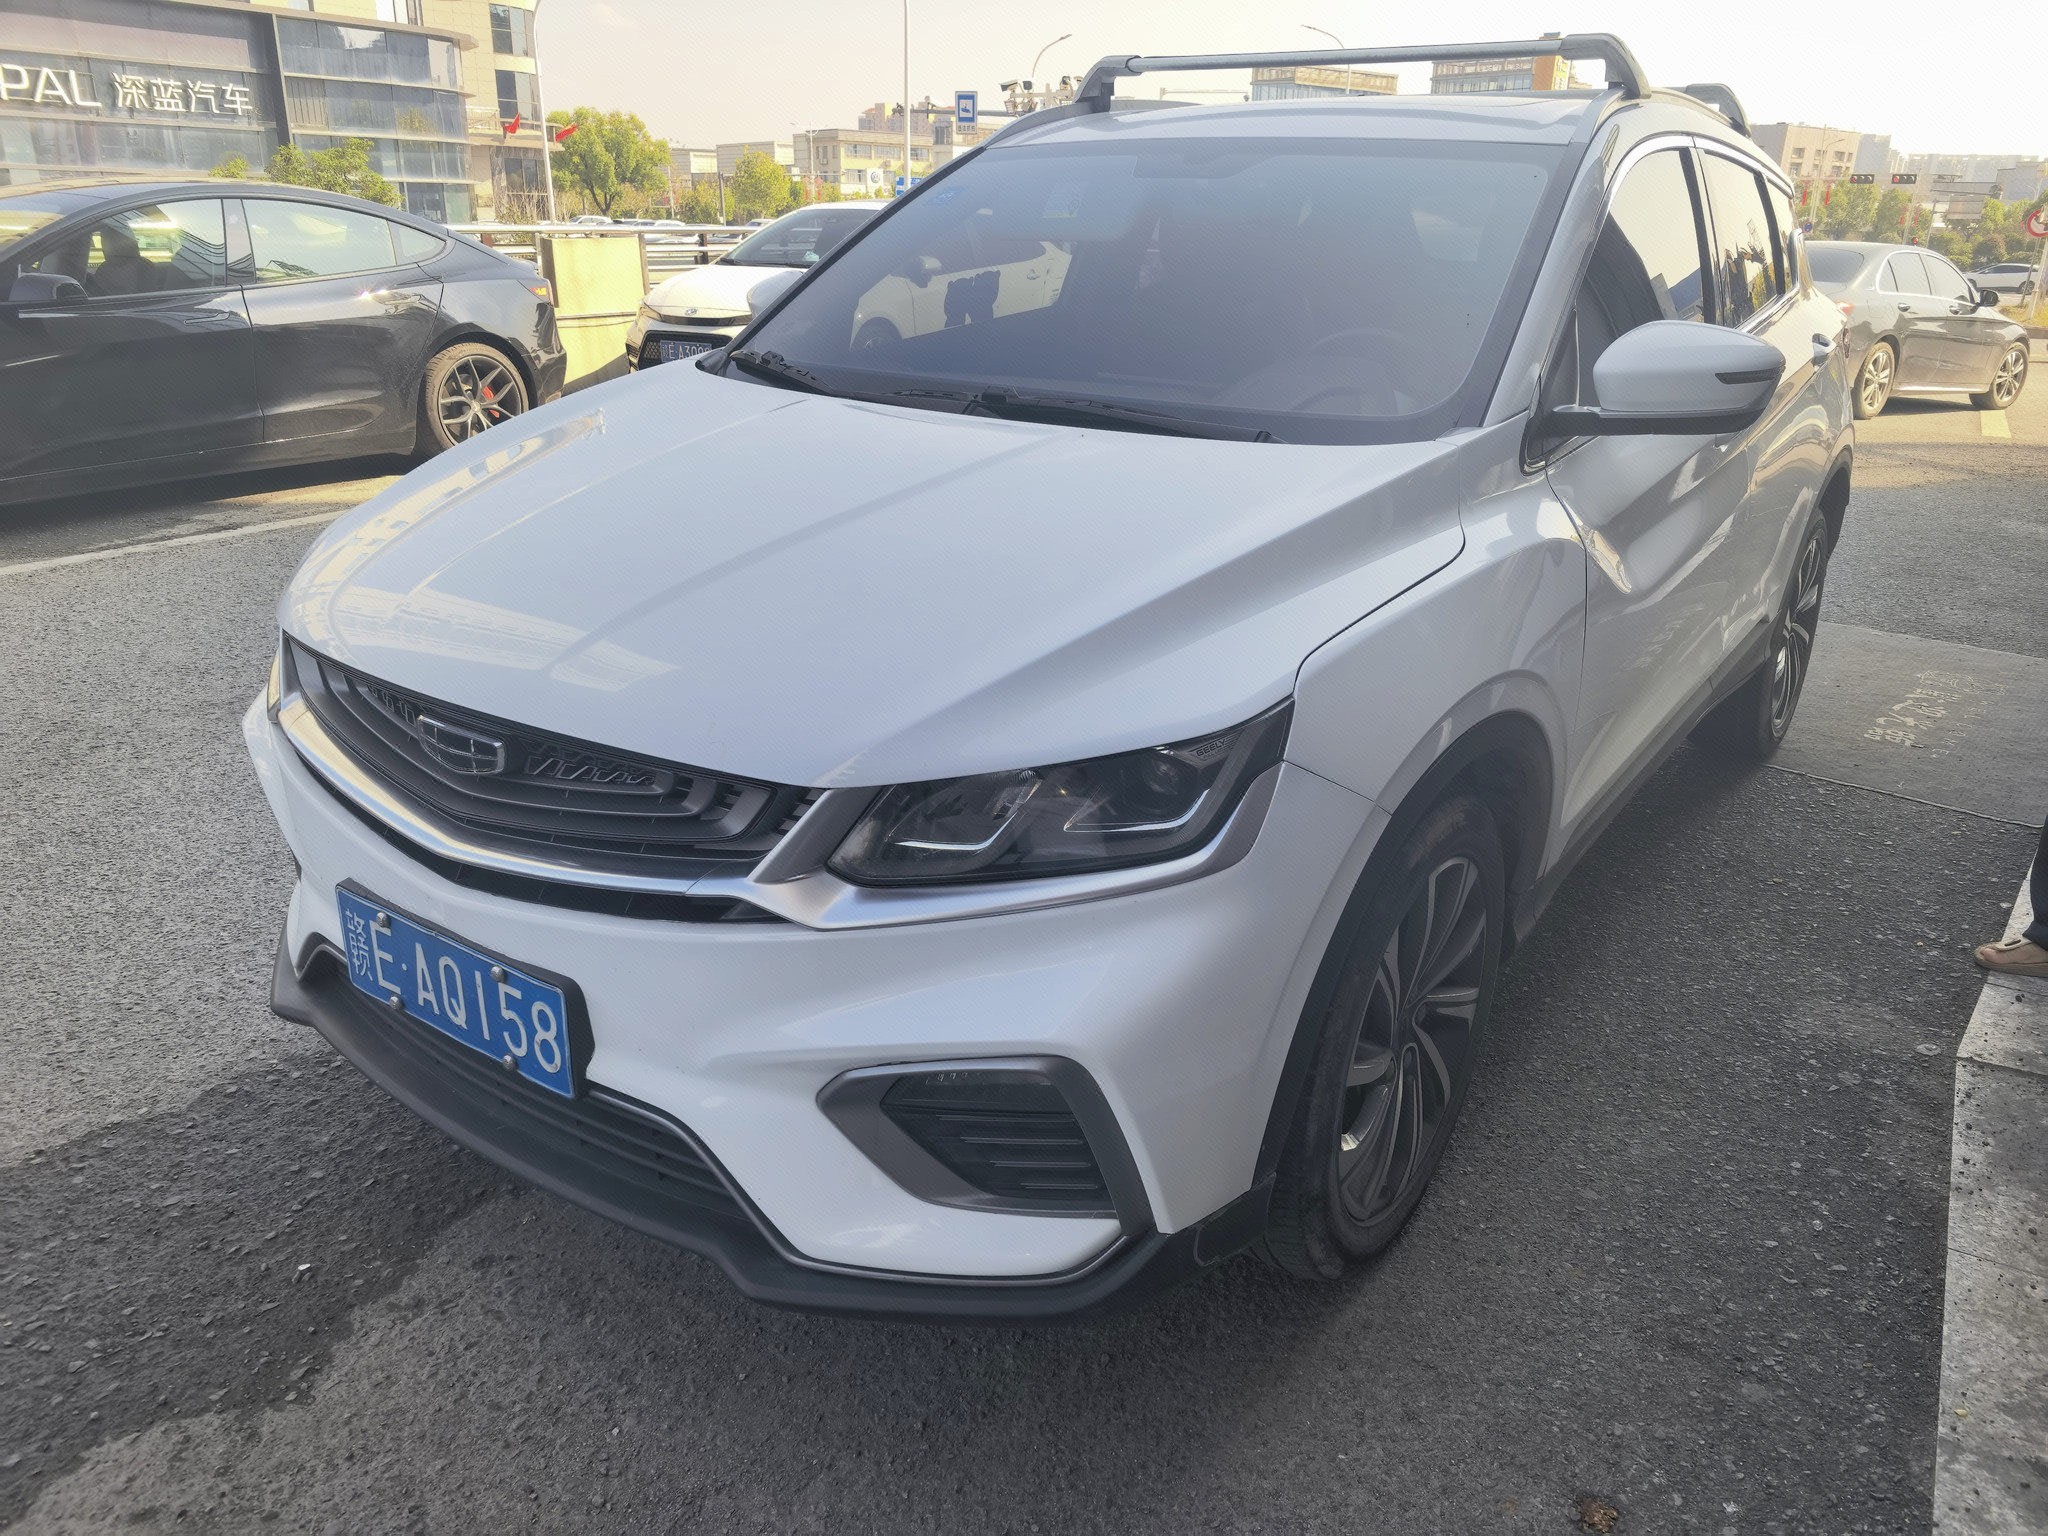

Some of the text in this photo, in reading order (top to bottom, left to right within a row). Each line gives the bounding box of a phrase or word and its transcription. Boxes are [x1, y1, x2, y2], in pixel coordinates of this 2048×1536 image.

[111, 72, 253, 116] 深蓝汽车
[1196, 739, 1226, 756] GEELY
